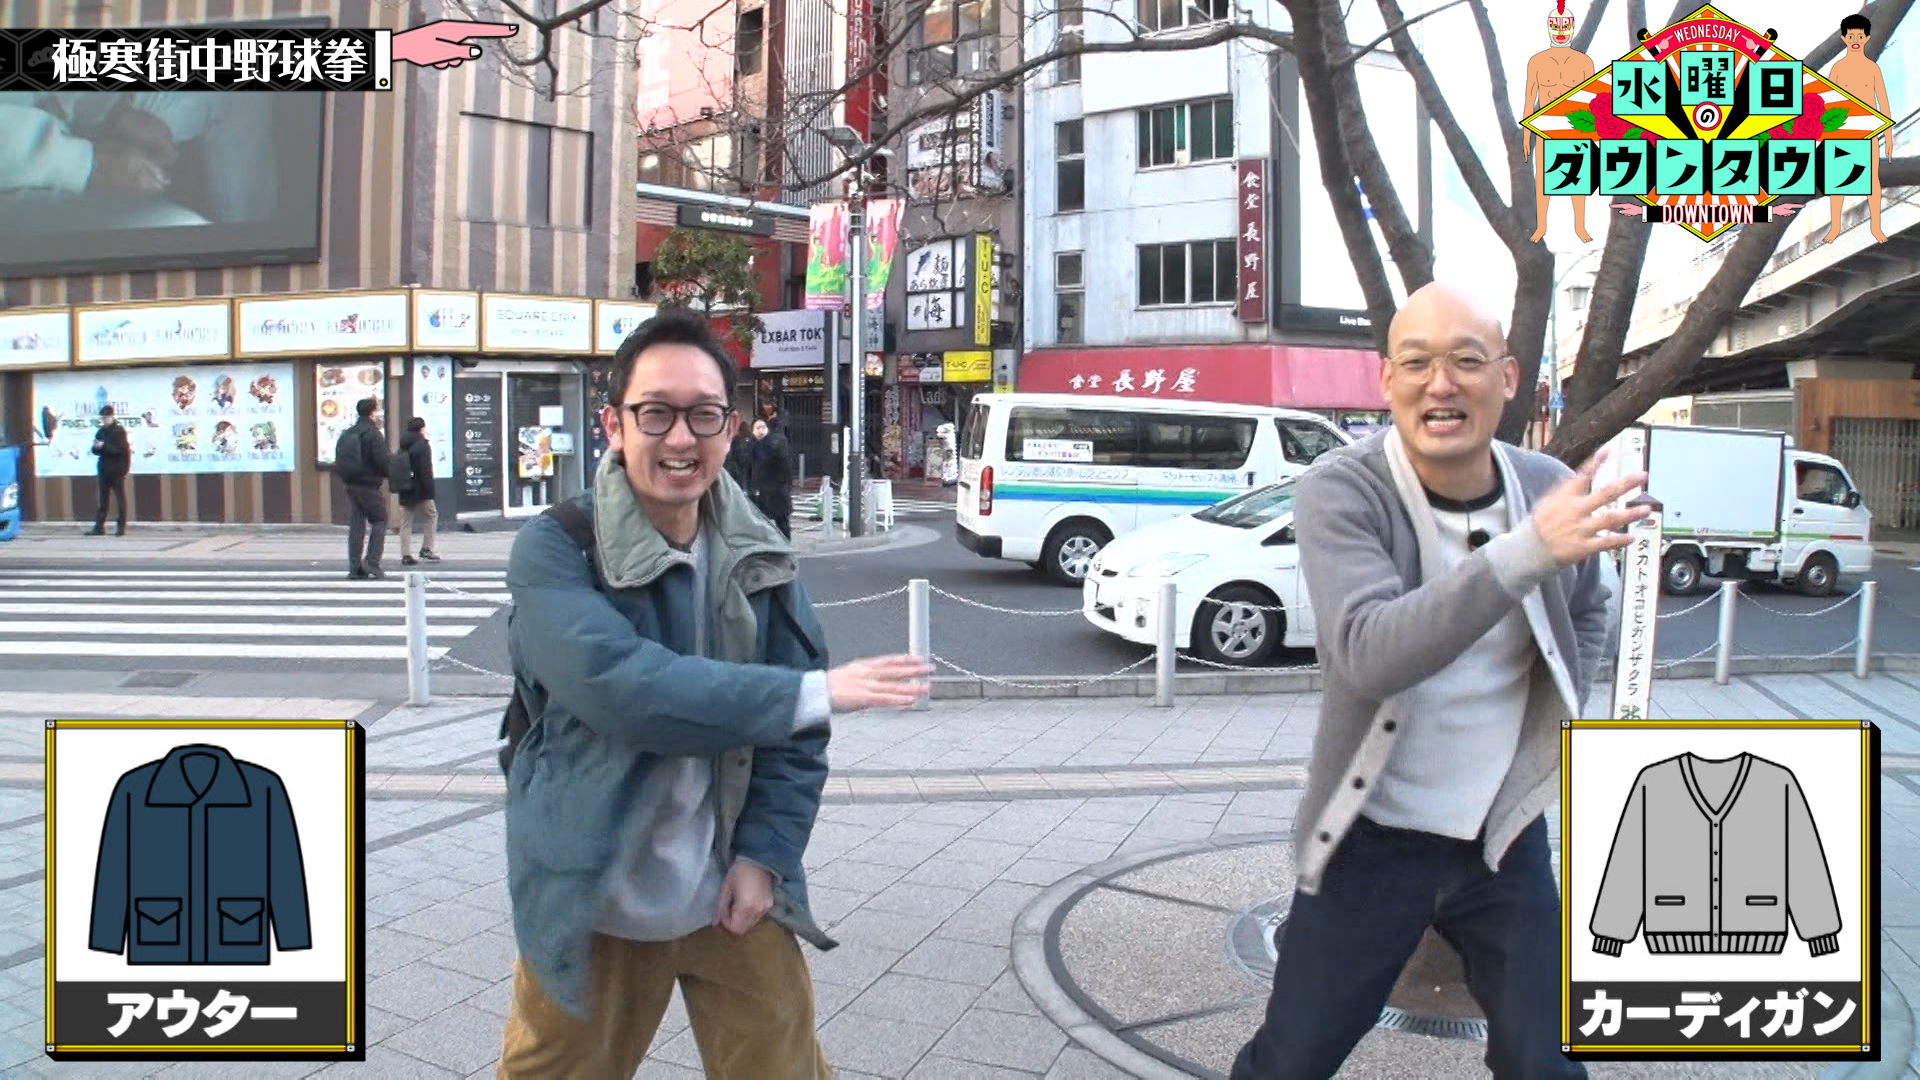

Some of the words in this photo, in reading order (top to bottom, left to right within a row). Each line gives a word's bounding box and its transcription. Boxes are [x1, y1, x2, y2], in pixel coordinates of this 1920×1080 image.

[1627, 537, 1650, 696] タカトオコヒガンザクラ
